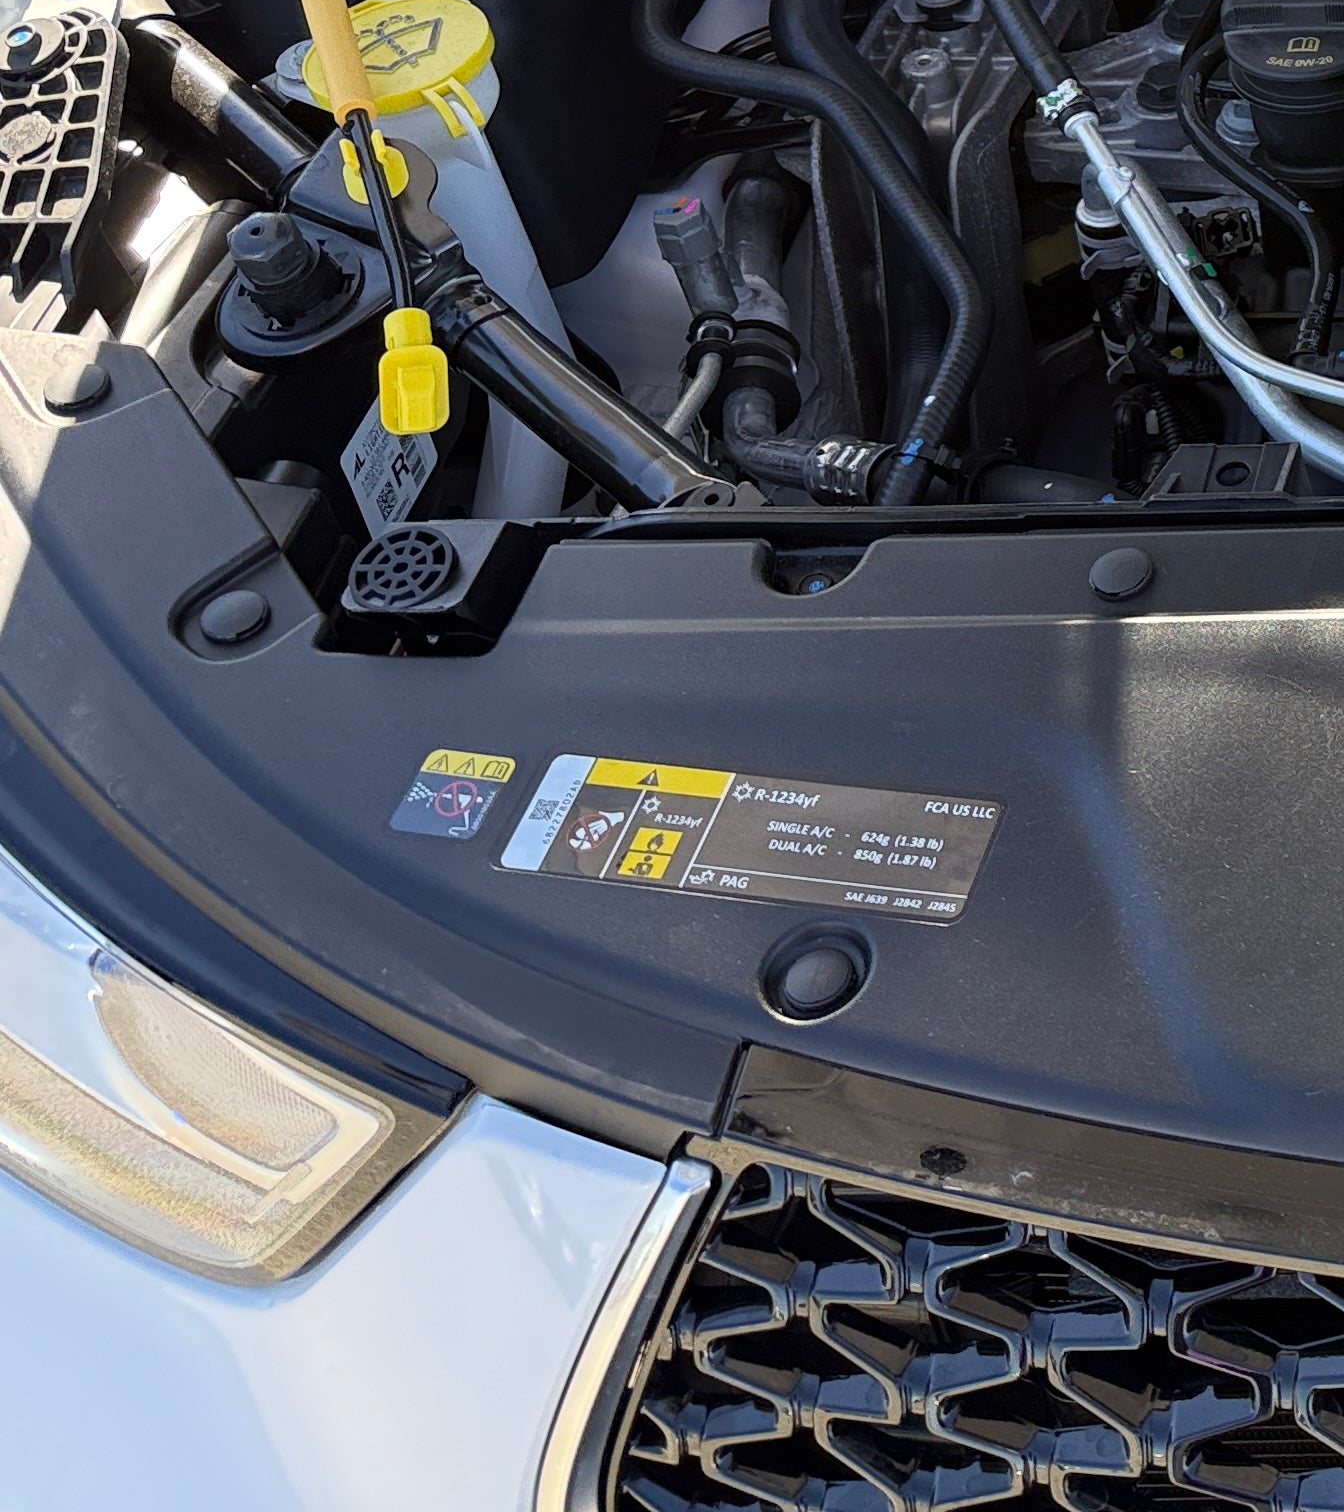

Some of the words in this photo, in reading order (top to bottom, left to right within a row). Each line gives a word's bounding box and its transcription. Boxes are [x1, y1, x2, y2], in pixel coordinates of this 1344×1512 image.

[1265, 56, 1293, 67] SAE
[1294, 55, 1334, 68] 0W-20
[391, 452, 411, 488] R
[753, 787, 821, 809] R-1234yf
[924, 801, 950, 814] FCA
[952, 804, 972, 816] US
[972, 806, 997, 819] LLC
[653, 814, 704, 828] R-1234yf
[766, 820, 810, 836] SINGLE
[810, 825, 835, 839] A/C
[860, 831, 890, 847] 624g
[894, 834, 926, 850] (1.38
[926, 837, 944, 852] lb)
[768, 839, 802, 854] DUAL
[803, 843, 828, 856] A/C
[853, 849, 883, 865] 850g
[887, 852, 918, 867] (1.87
[919, 855, 937, 870] lb)
[719, 875, 750, 889] PAG
[844, 891, 864, 902] SAE
[865, 894, 888, 905] J639
